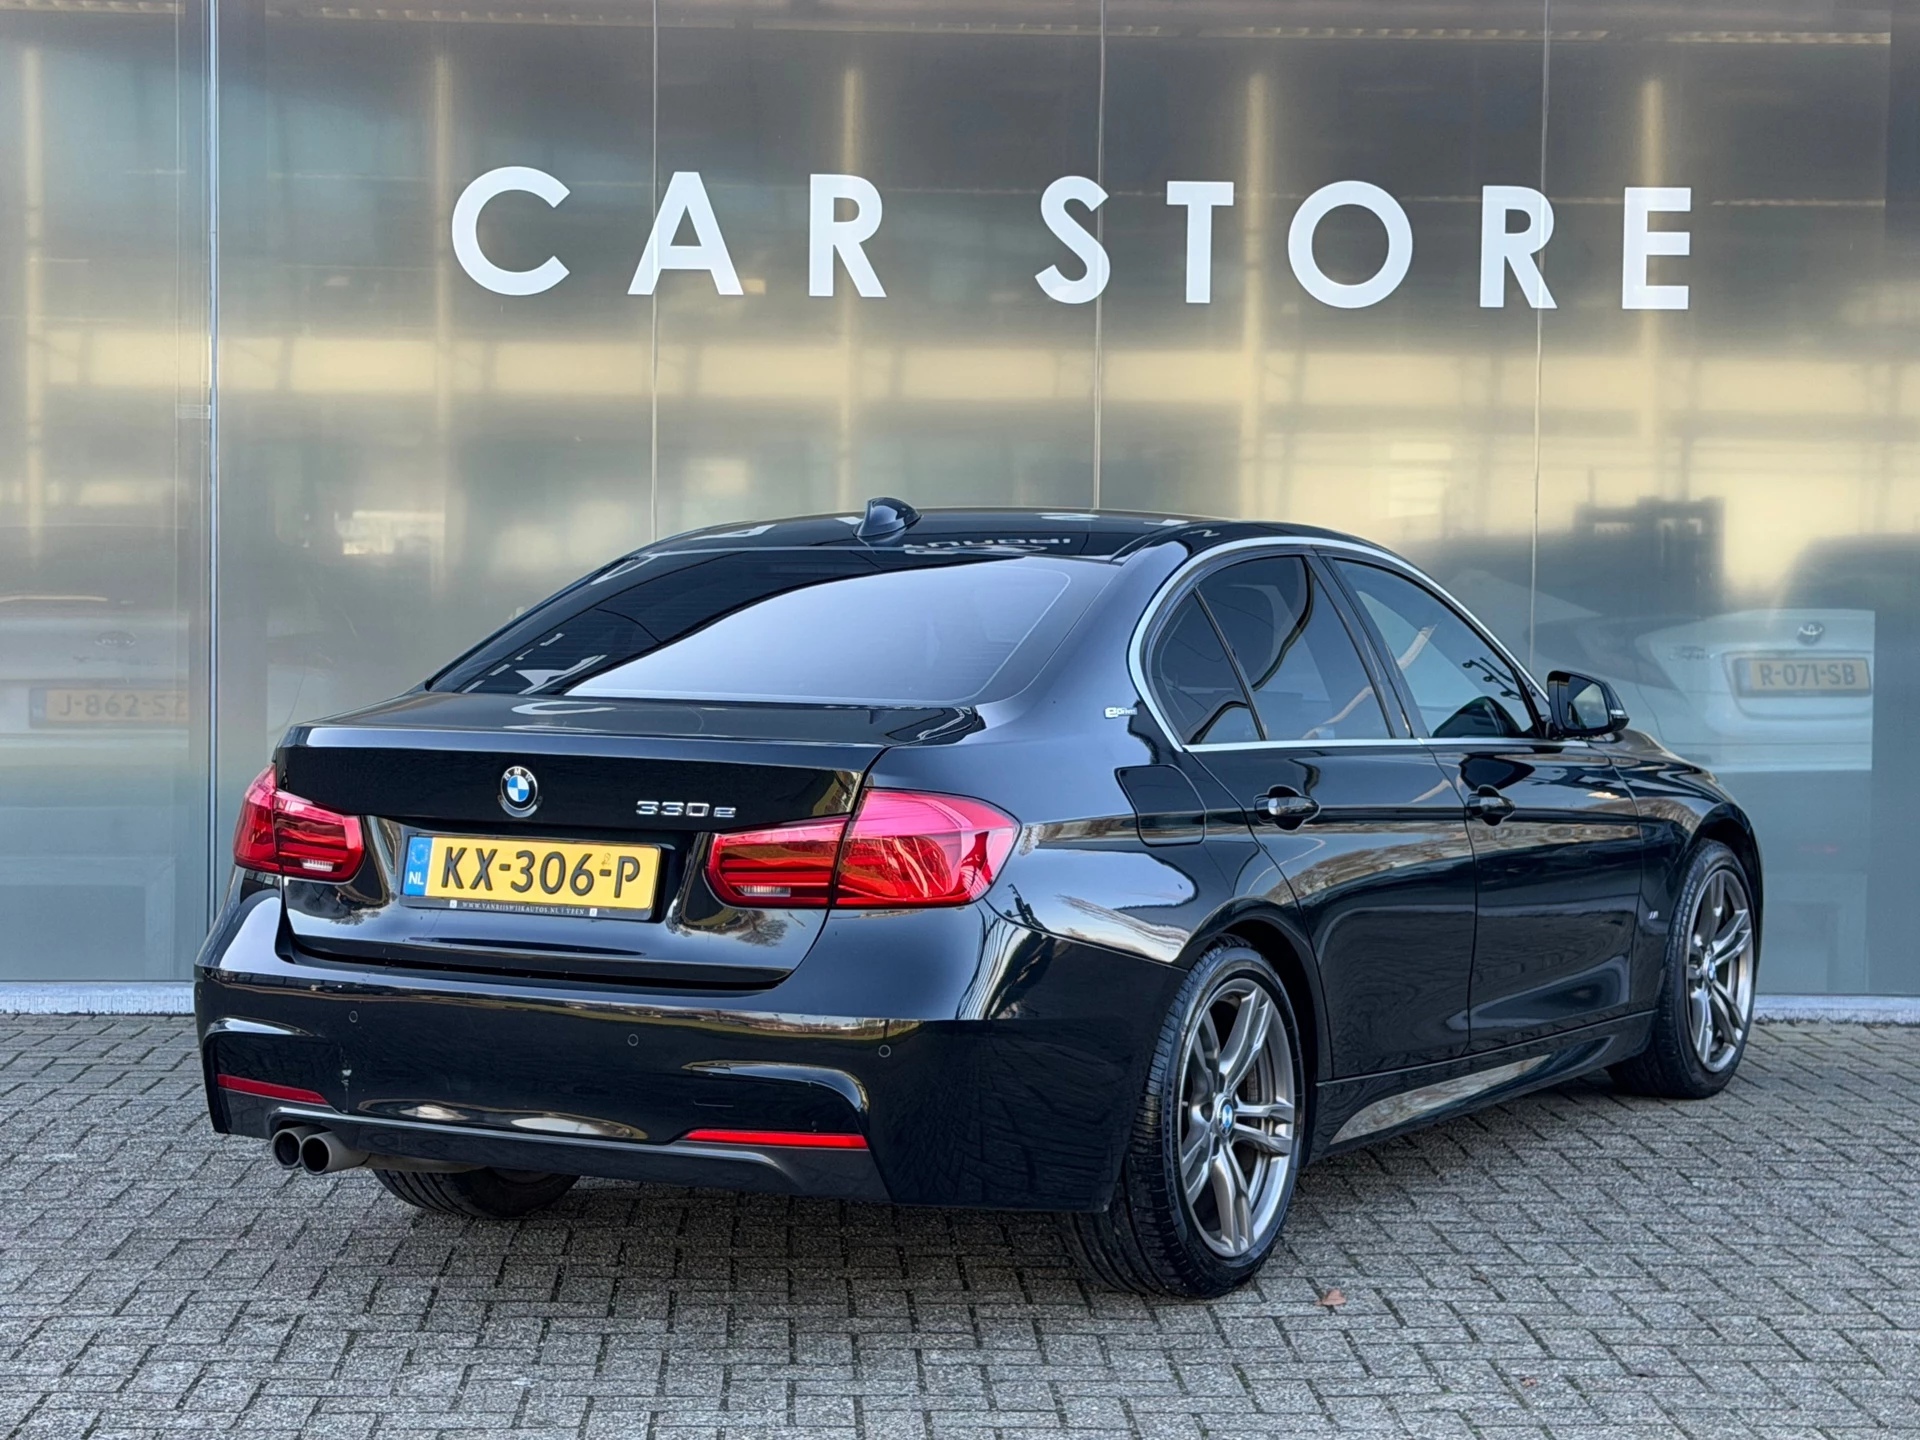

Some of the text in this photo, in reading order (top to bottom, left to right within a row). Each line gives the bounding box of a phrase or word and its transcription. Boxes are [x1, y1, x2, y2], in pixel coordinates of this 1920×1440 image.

[451, 165, 1691, 310] CAR STORE
[1759, 663, 1857, 687] R-071-SB
[503, 767, 534, 783] BMW
[636, 800, 737, 818] 330e
[408, 871, 424, 885] NL
[441, 846, 641, 899] KX-306-P
